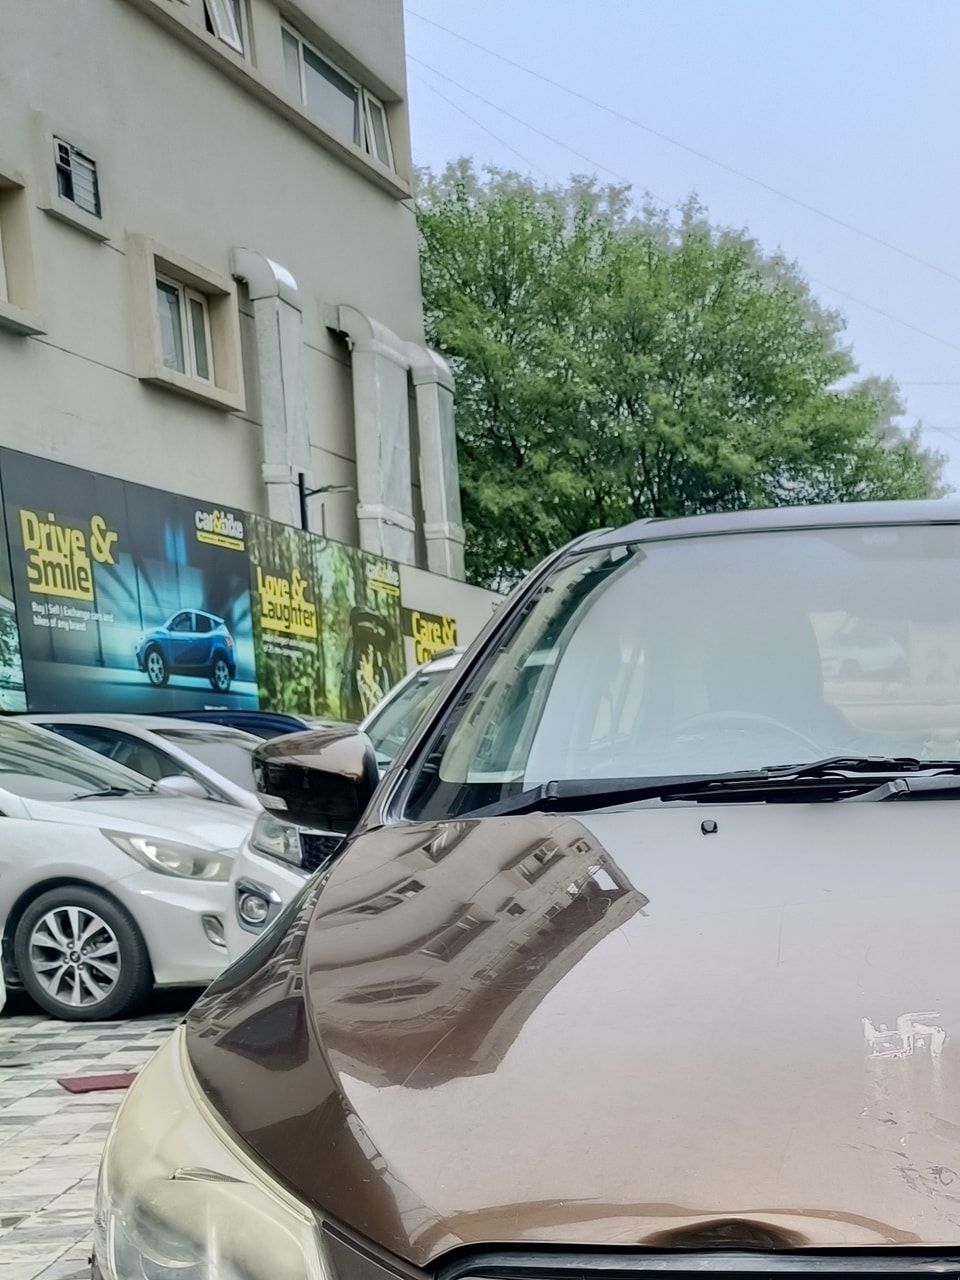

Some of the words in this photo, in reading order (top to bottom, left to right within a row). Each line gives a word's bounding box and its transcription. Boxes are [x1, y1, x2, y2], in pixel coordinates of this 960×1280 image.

[20, 509, 86, 555] Drive
[90, 514, 118, 564] &
[195, 510, 244, 539] car&bike
[27, 548, 90, 593] Smile
[257, 566, 290, 598] Love
[291, 569, 308, 601] &
[32, 602, 45, 615] Buy
[48, 603, 60, 615] Sell
[261, 594, 315, 629] Laughter
[69, 620, 87, 631] brand
[412, 611, 442, 643] Care
